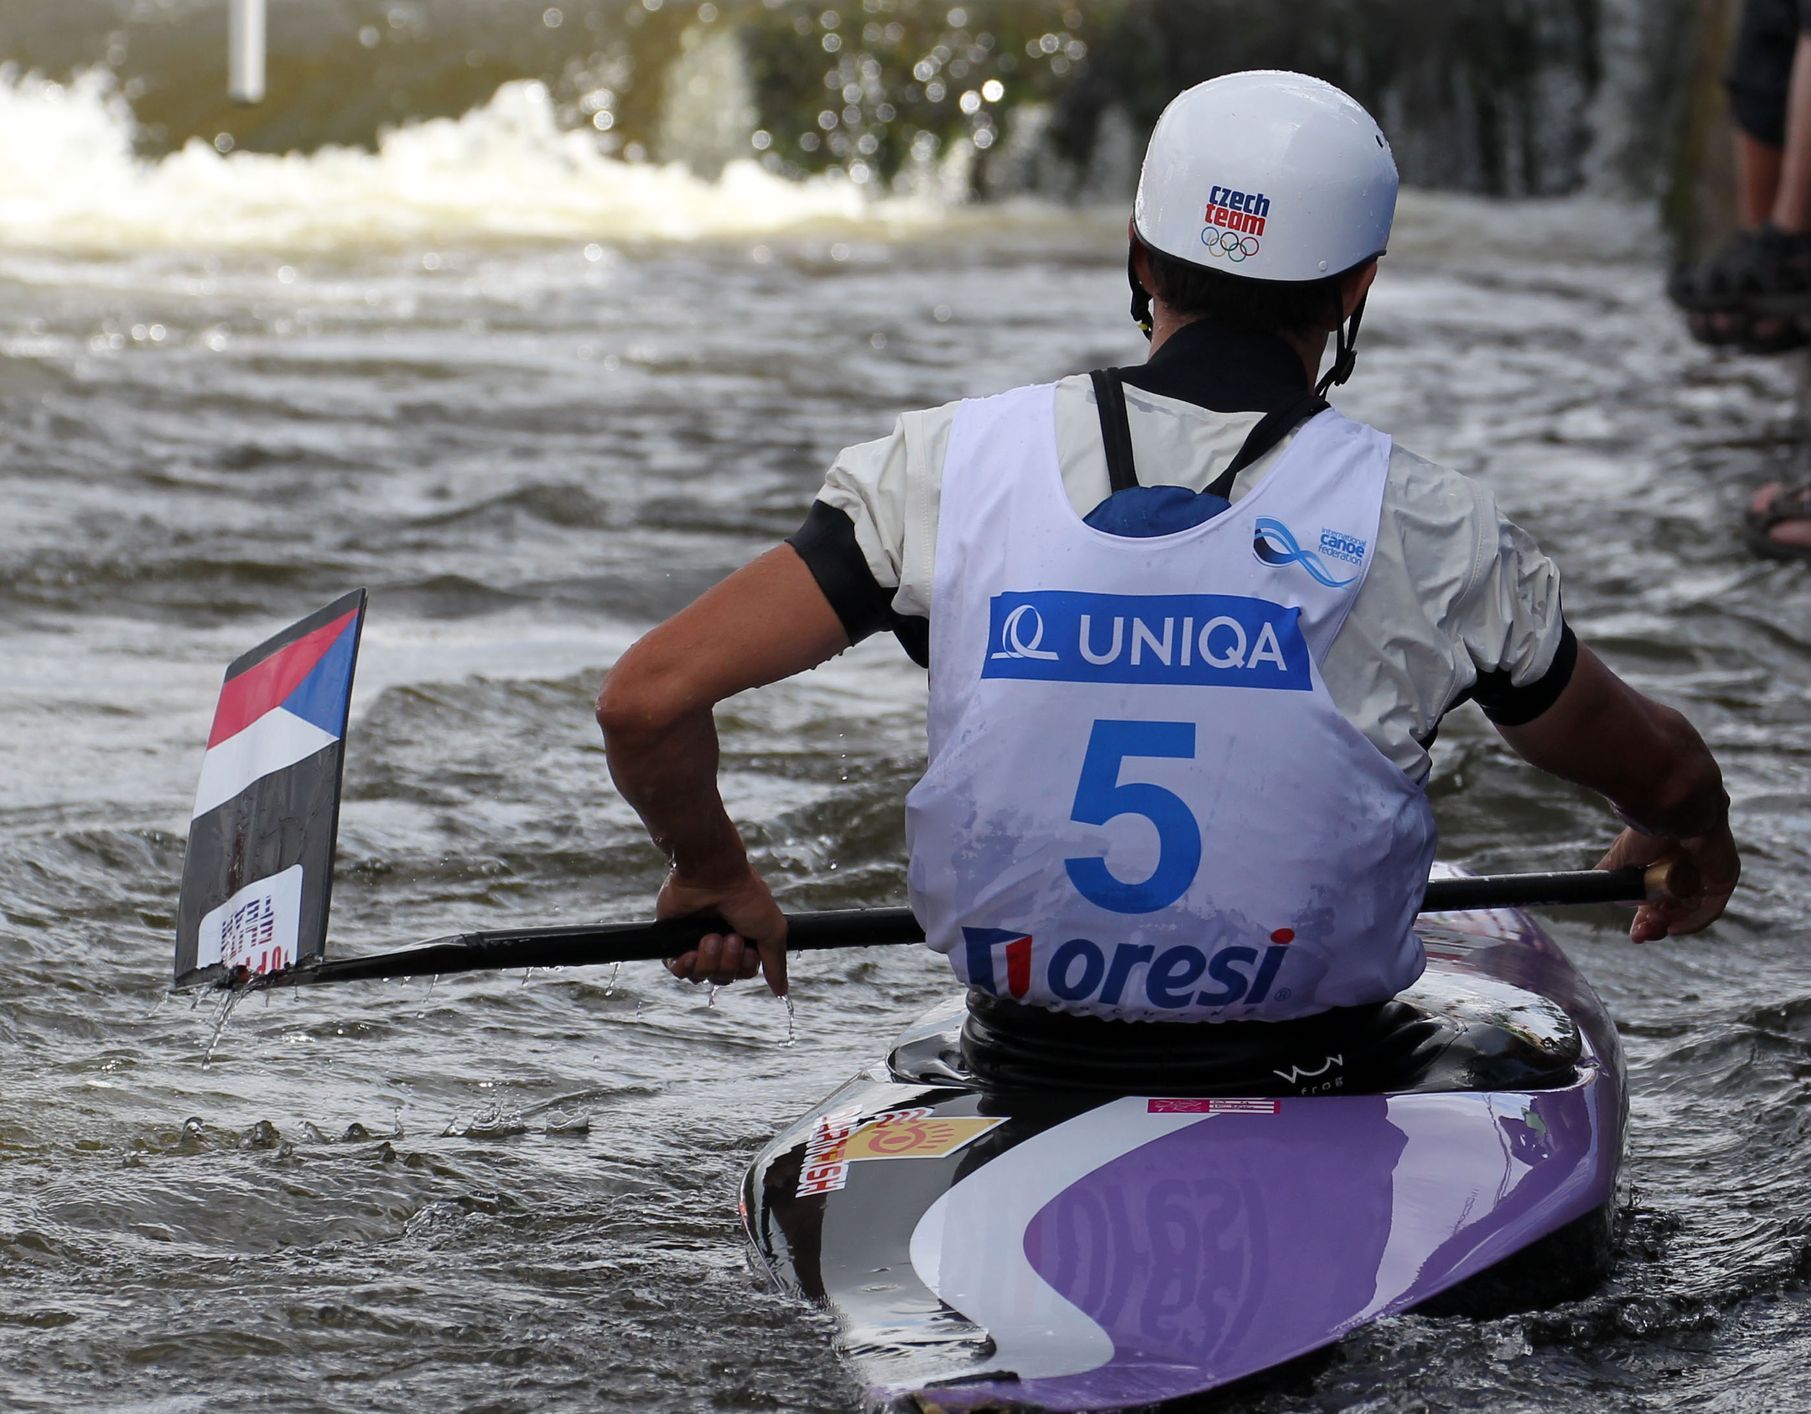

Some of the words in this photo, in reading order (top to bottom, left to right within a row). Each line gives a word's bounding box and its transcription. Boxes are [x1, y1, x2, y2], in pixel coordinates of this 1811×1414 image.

[1209, 185, 1271, 218] czech
[1204, 203, 1266, 237] team
[1320, 533, 1365, 558] canoe
[1321, 527, 1366, 546] international
[1318, 544, 1362, 566] federation
[1079, 613, 1288, 671] UNIQA
[1064, 719, 1202, 915] 5
[1047, 928, 1296, 1009] oresi
